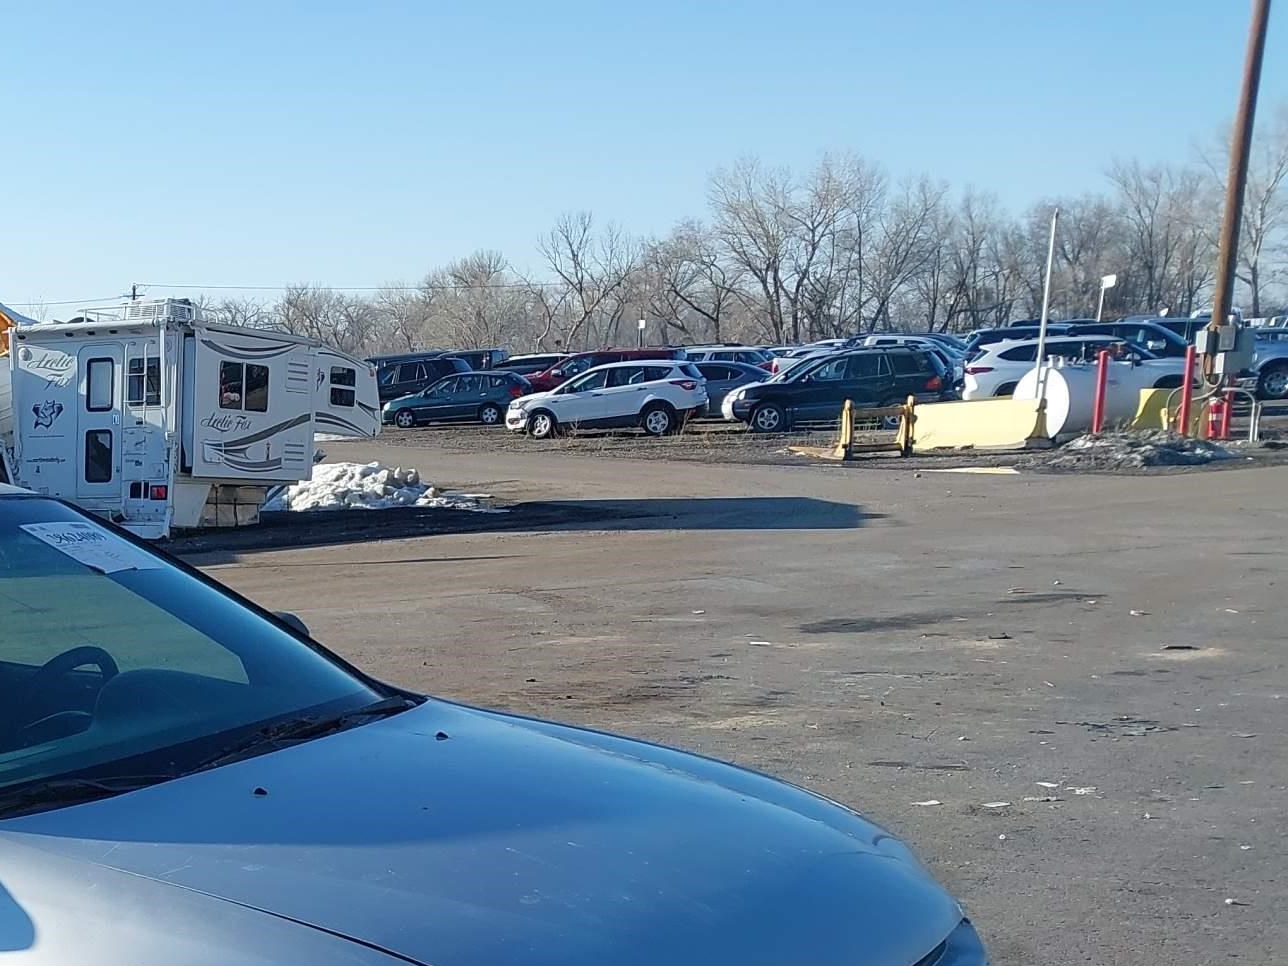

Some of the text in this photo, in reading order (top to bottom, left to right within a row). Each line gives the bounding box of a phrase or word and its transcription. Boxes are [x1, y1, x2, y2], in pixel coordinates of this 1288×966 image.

[27, 353, 73, 371] Arctic
[44, 373, 70, 391] Fox
[200, 412, 252, 432] Arctic Fox
